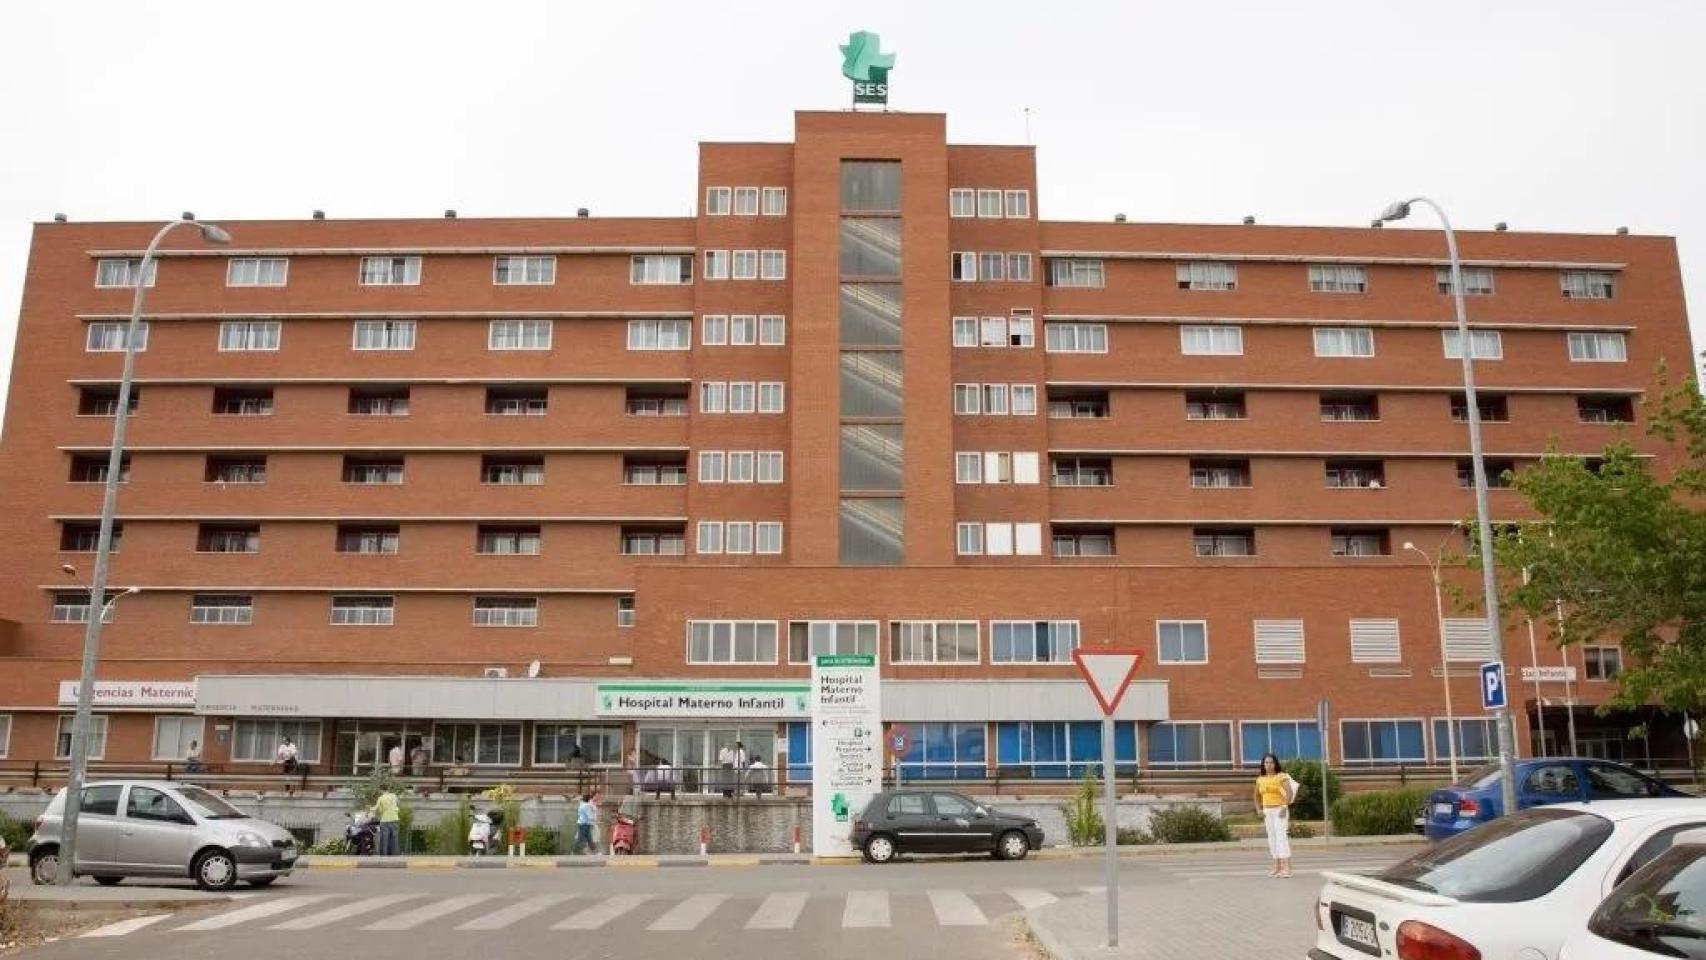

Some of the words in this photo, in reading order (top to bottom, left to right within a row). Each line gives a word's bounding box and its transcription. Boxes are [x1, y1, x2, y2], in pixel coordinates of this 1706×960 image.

[855, 83, 887, 95] SES
[821, 675, 863, 685] Hospital
[1485, 671, 1498, 701] P
[73, 686, 133, 699] Uencias
[821, 686, 864, 694] Materno
[619, 696, 673, 710] Hospital
[678, 697, 733, 708] Materno
[739, 697, 784, 708] Infantil
[821, 695, 856, 704] Infantil
